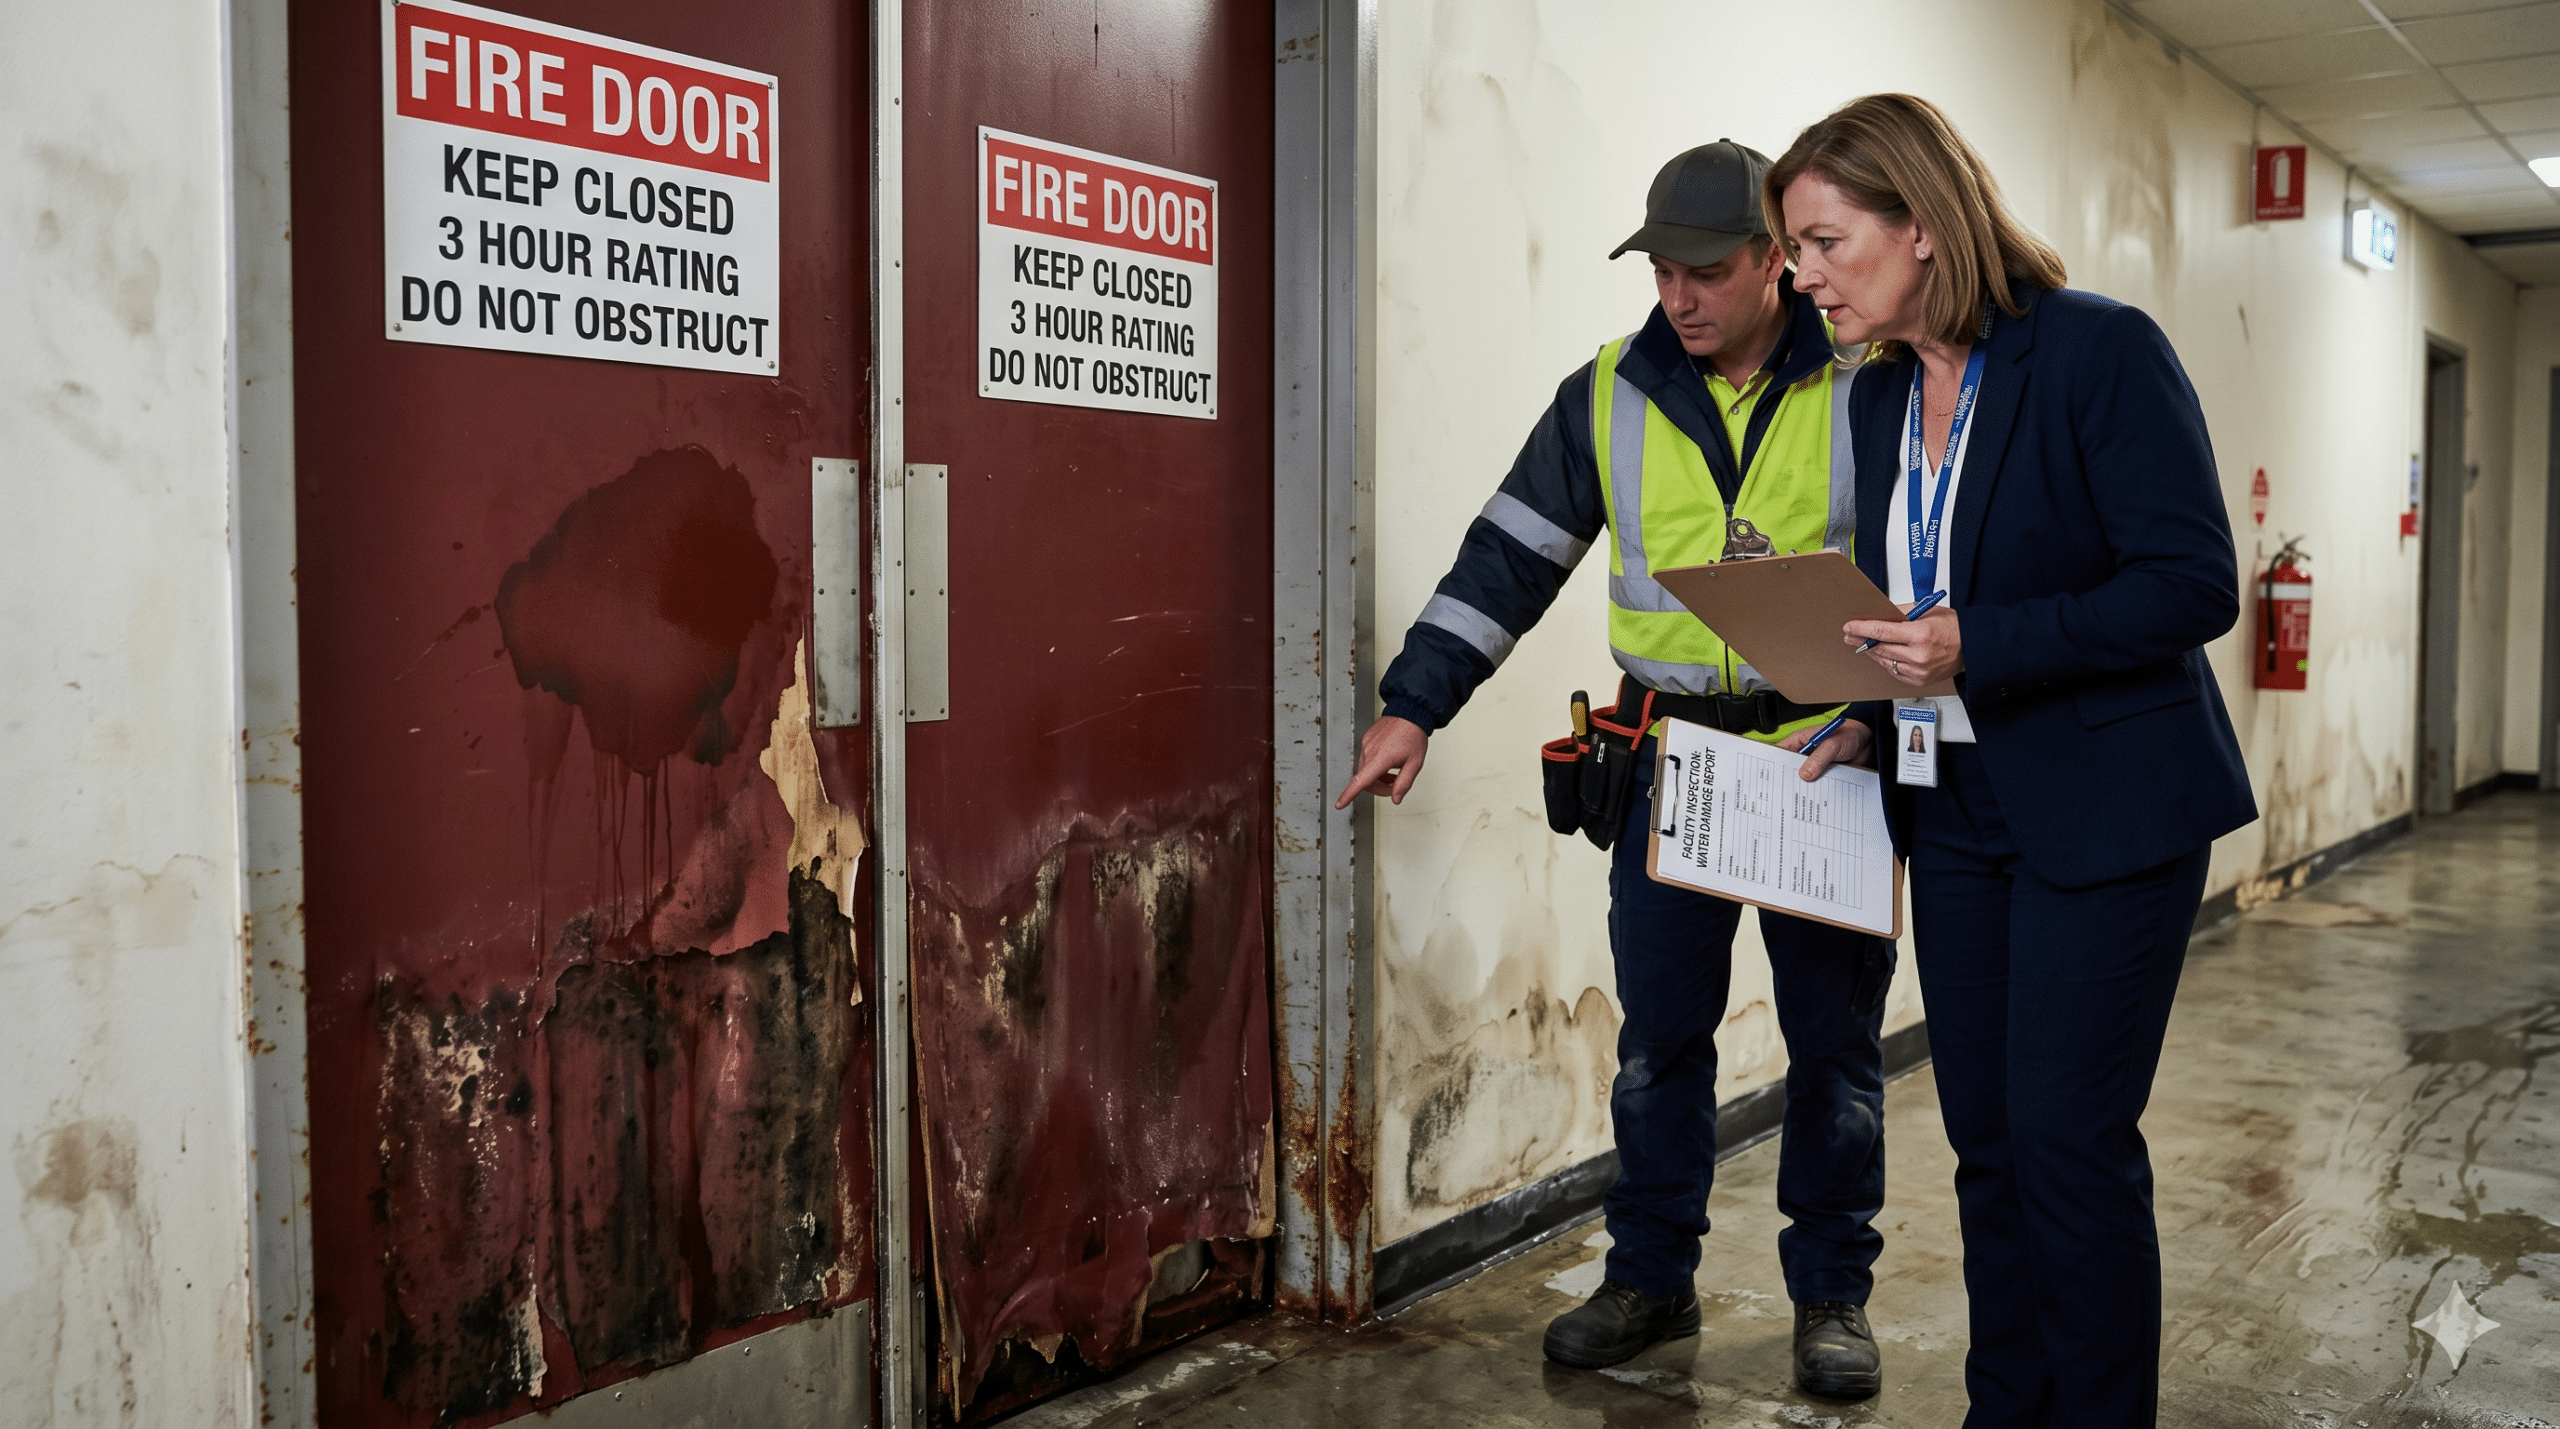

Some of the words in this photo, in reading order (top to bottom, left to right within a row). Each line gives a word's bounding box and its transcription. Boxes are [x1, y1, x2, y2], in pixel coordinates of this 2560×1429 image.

[411, 26, 566, 127] FIRE
[592, 64, 762, 164] DOOR
[444, 143, 559, 207] KEEP
[574, 167, 734, 236] CLOSED
[995, 154, 1089, 229] FIRE
[1103, 178, 1208, 252] DOOR
[438, 216, 464, 261] 3
[479, 220, 592, 278] HOUR
[606, 238, 740, 297] RATING
[1013, 244, 1084, 291] KEEP
[1093, 258, 1192, 309] CLOSED
[401, 275, 462, 326] DO
[478, 284, 561, 336] NOT
[575, 297, 769, 358] OBSTRUCT
[1010, 299, 1026, 334] 3
[1035, 302, 1103, 345] HOUR
[1111, 314, 1194, 357] RATING
[989, 347, 1025, 385] DO
[1034, 352, 1084, 391] NOT
[1092, 359, 1212, 405] OBSTRUCT
[1685, 750, 1702, 815] INSPECTION:
[1703, 746, 1716, 787] REPORT
[1682, 815, 1696, 860] FACILITY
[1699, 788, 1714, 833] DAMAGE
[1696, 833, 1710, 869] WATER
